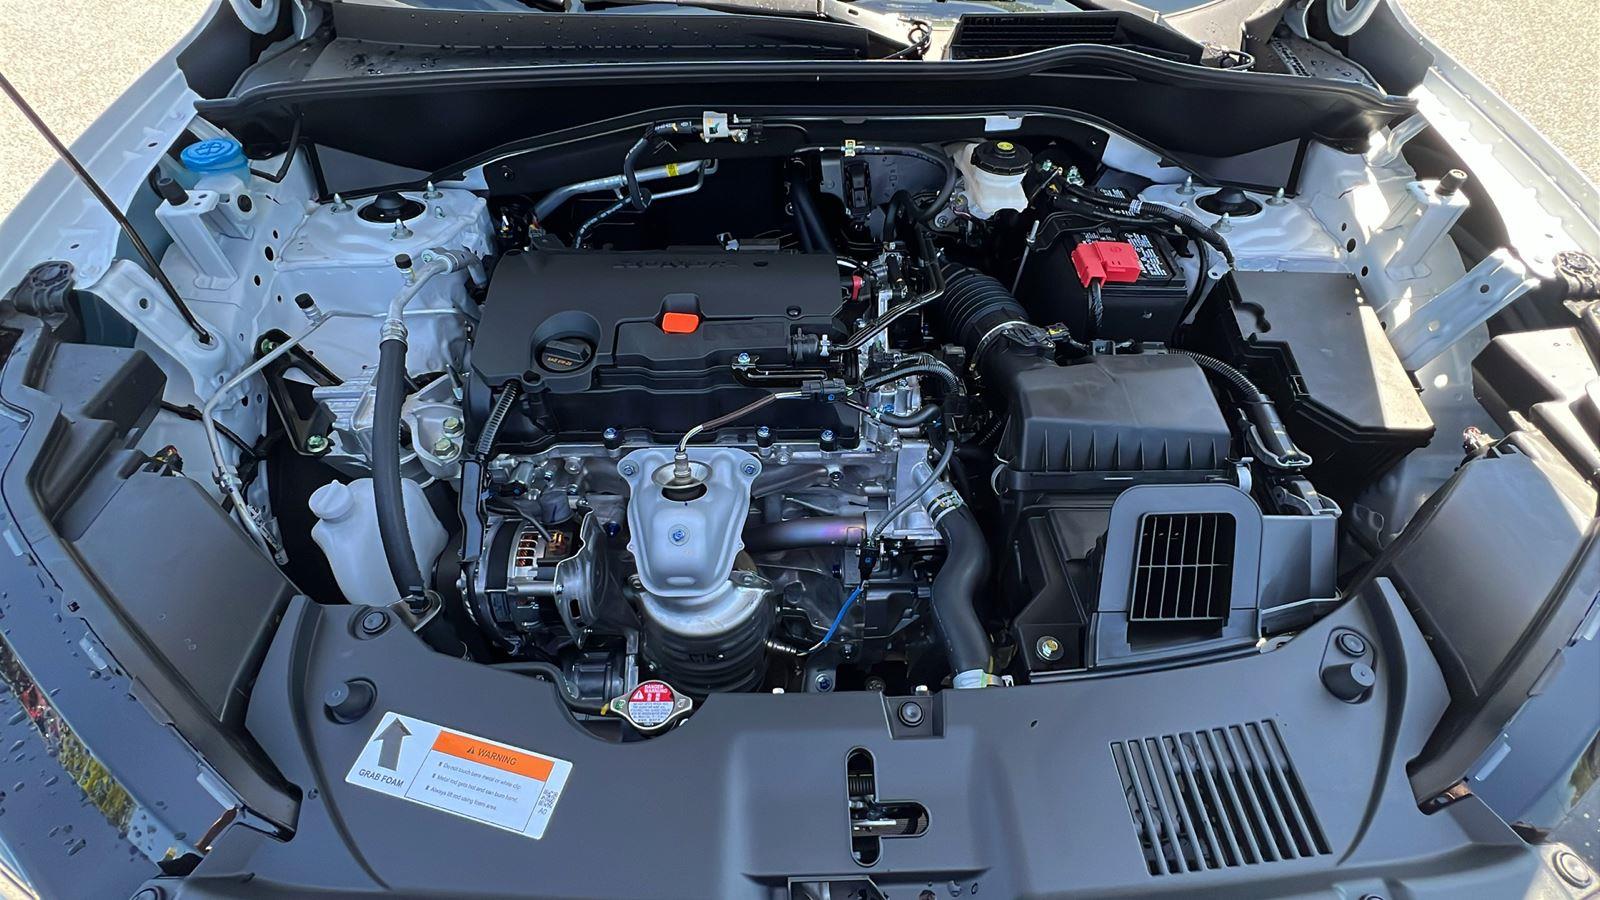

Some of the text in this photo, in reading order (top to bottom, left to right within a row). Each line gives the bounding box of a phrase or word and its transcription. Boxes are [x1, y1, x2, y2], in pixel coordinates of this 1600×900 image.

[478, 748, 518, 766] WARNING
[359, 769, 404, 788] GRAB FOAM
